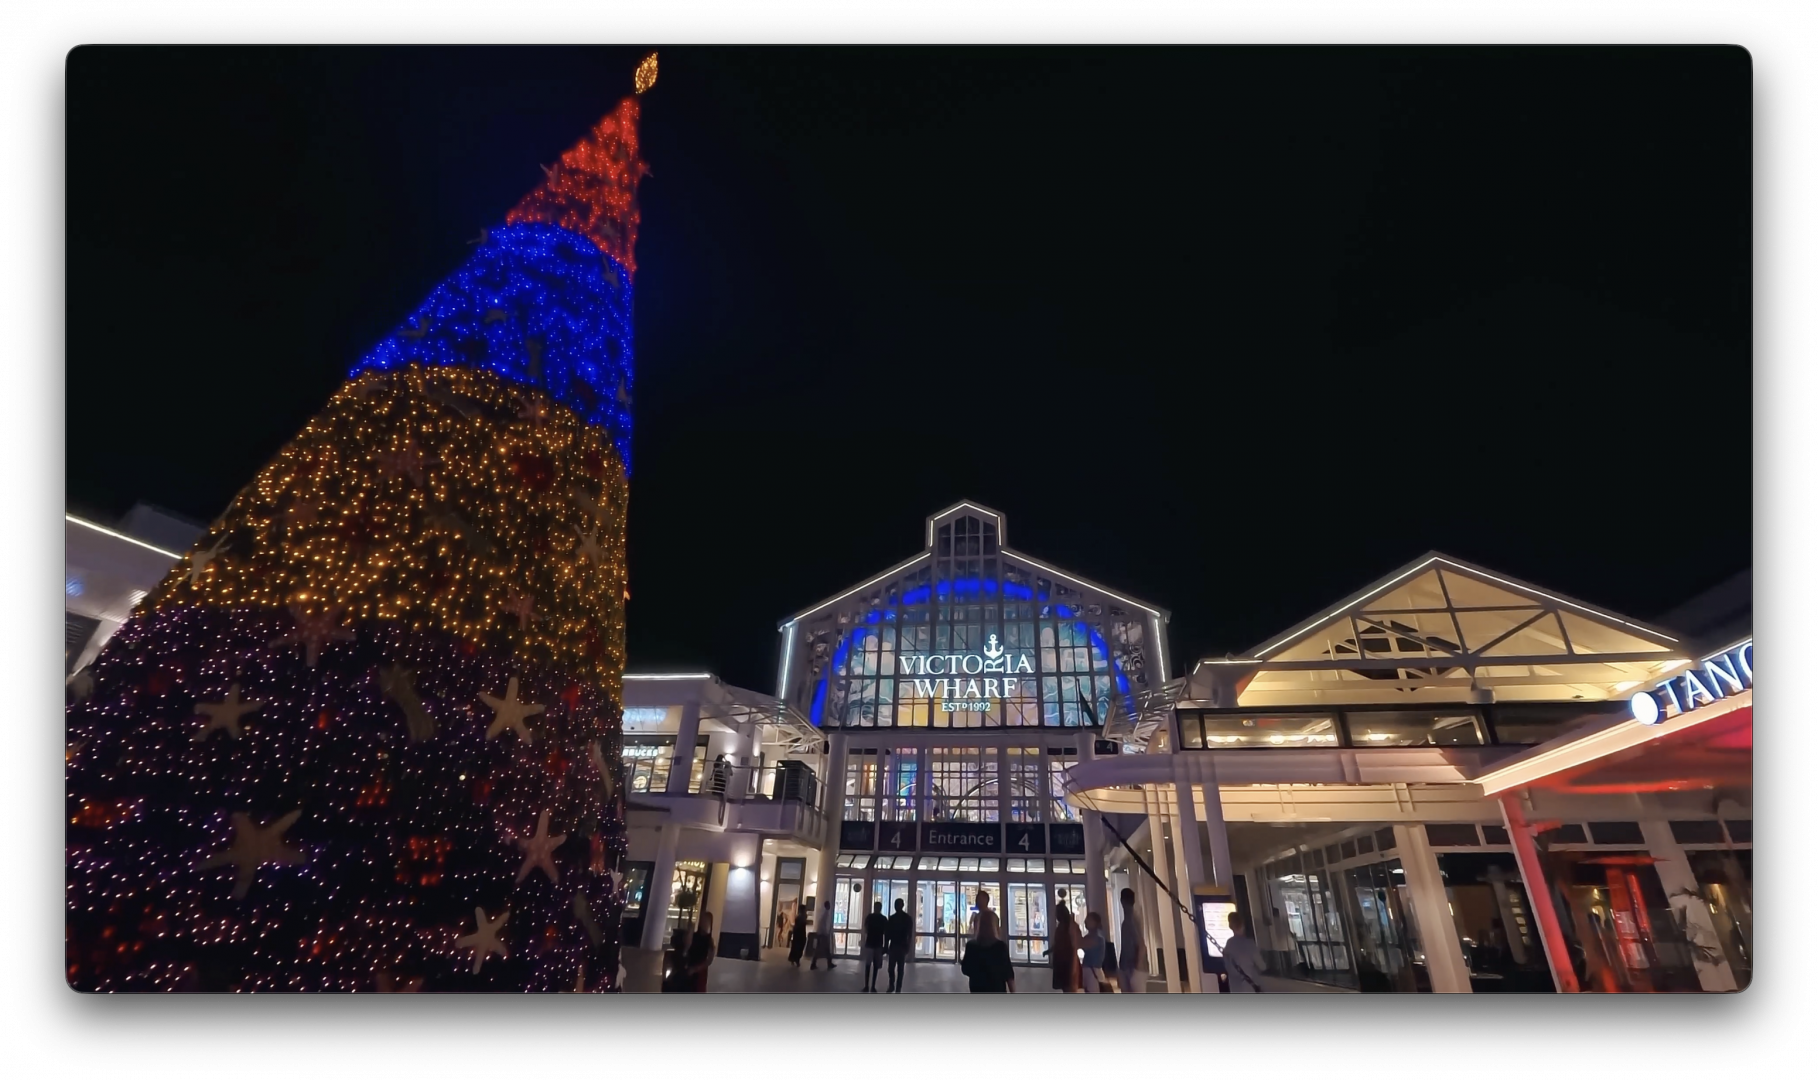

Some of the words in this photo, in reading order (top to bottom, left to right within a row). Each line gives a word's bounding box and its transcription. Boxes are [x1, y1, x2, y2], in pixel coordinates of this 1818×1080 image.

[899, 653, 1034, 675] VICTORIA
[914, 677, 1018, 699] WHARF
[969, 702, 991, 712] 1992
[890, 832, 901, 849] 4
[928, 829, 994, 846] Entrance
[1018, 832, 1030, 851] 4
